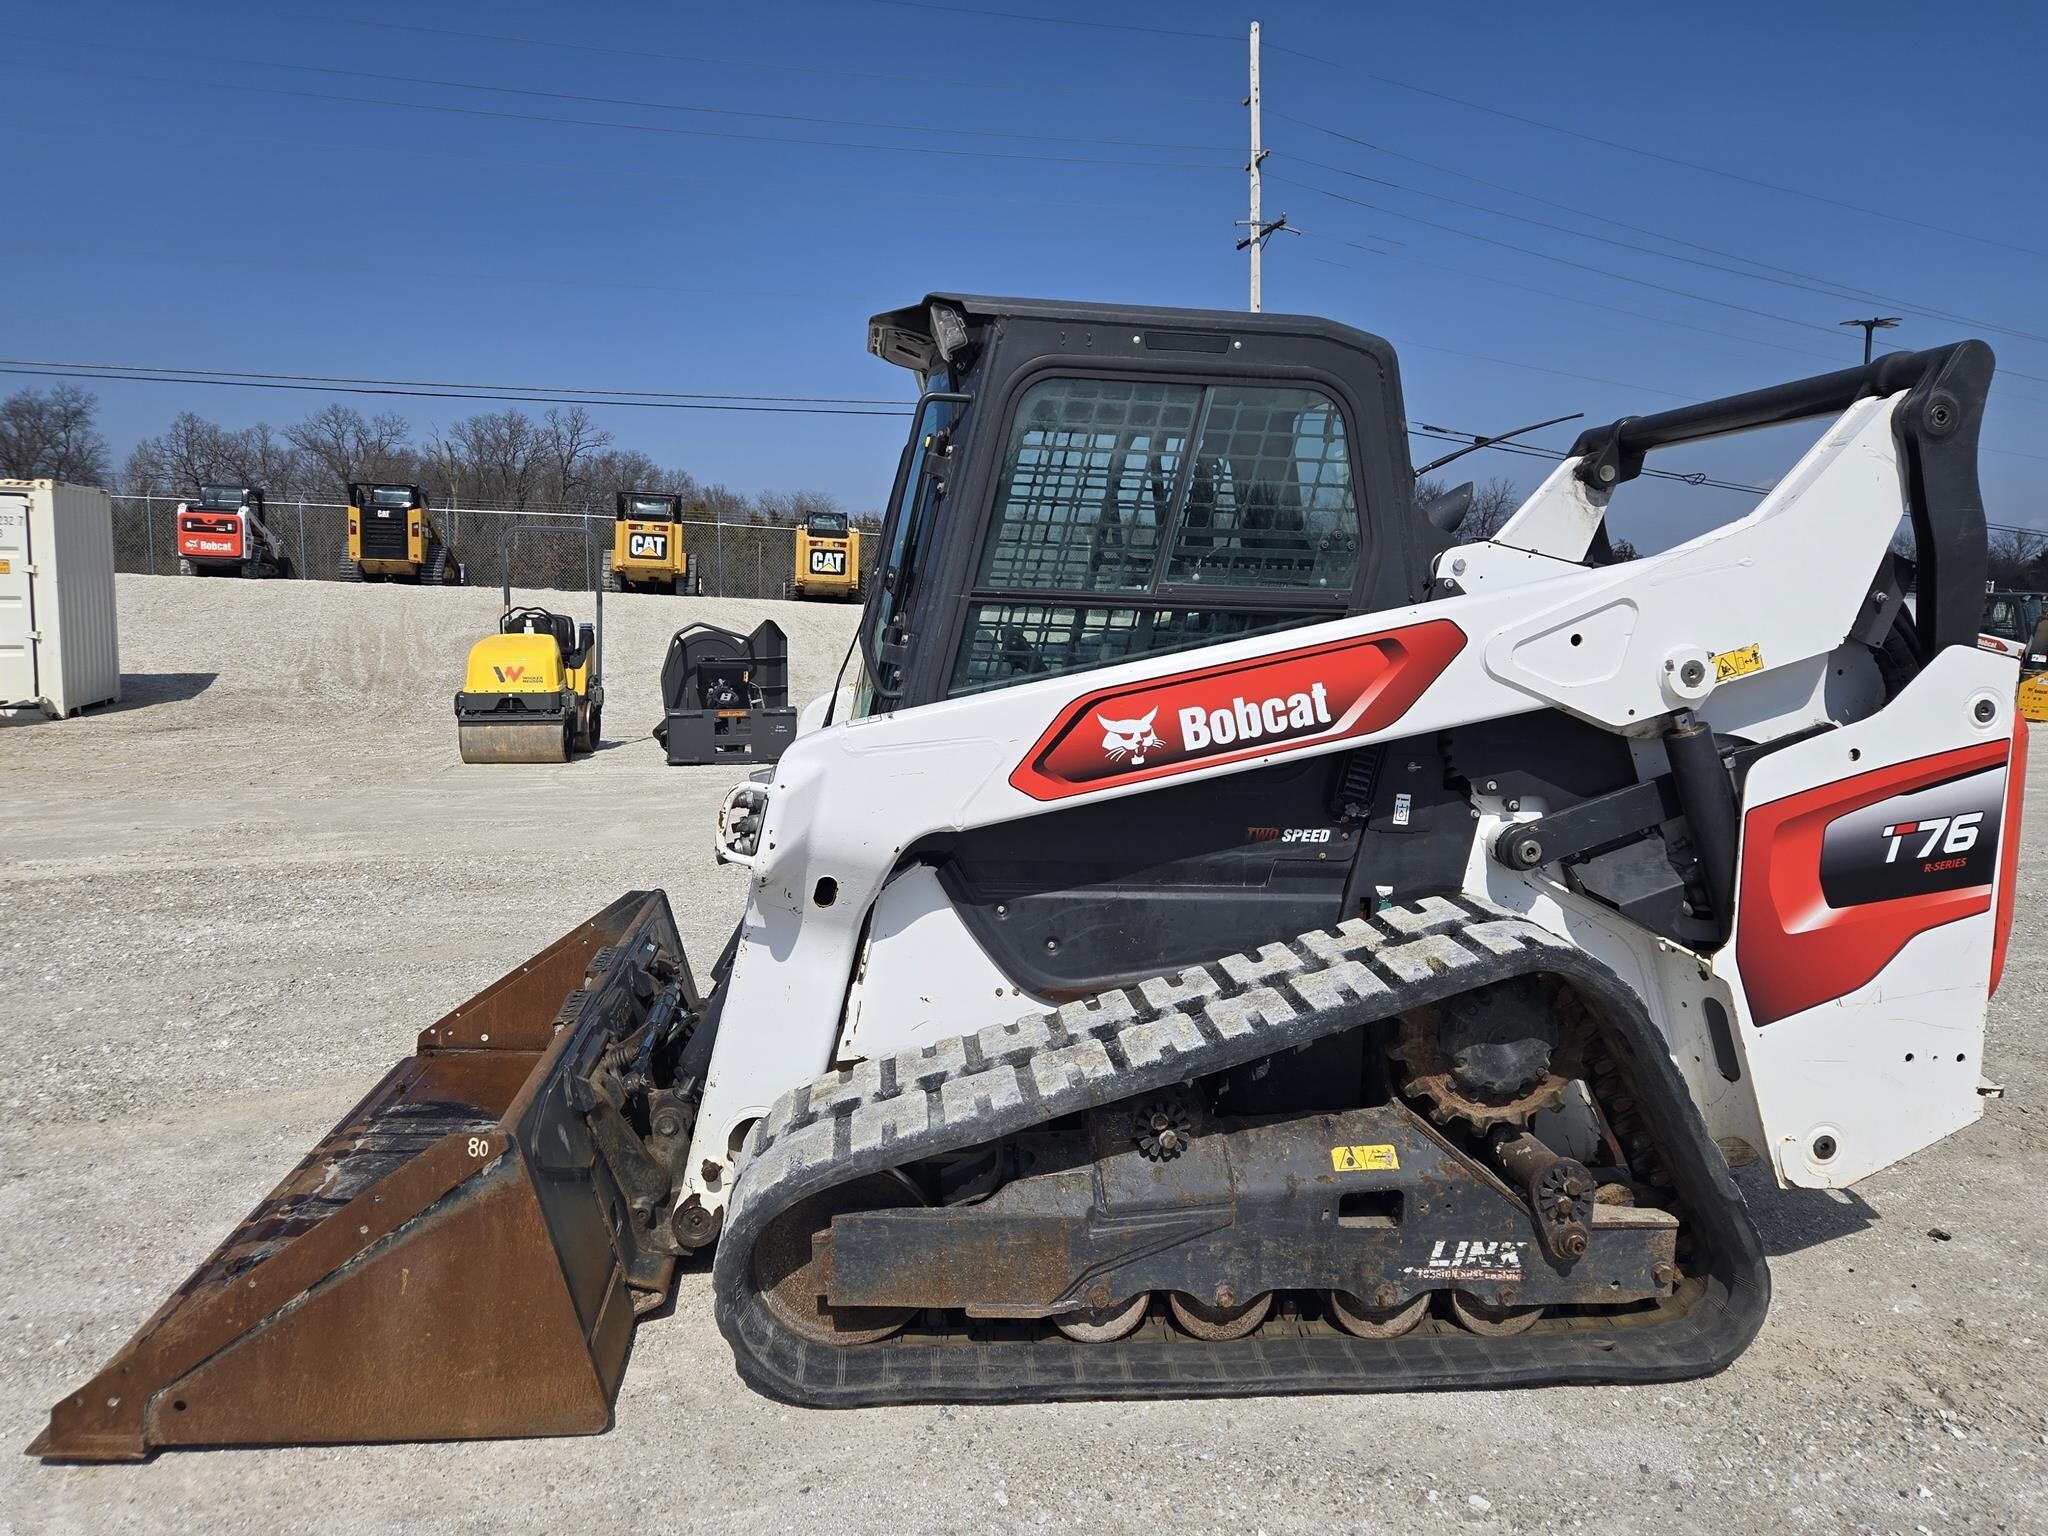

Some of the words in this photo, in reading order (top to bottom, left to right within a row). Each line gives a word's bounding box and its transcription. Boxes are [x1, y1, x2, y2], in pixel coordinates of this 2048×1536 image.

[377, 510, 390, 518] CAT
[200, 541, 232, 552] Bobcat
[631, 535, 665, 557] CAT
[812, 552, 845, 573] CAT
[1178, 682, 1332, 751] Bobcat
[1248, 827, 1280, 841] TWO
[1281, 828, 1331, 843] SPEED
[1882, 811, 1984, 863] T76
[1924, 857, 1967, 873] R-SERIES
[467, 1137, 489, 1158] 80
